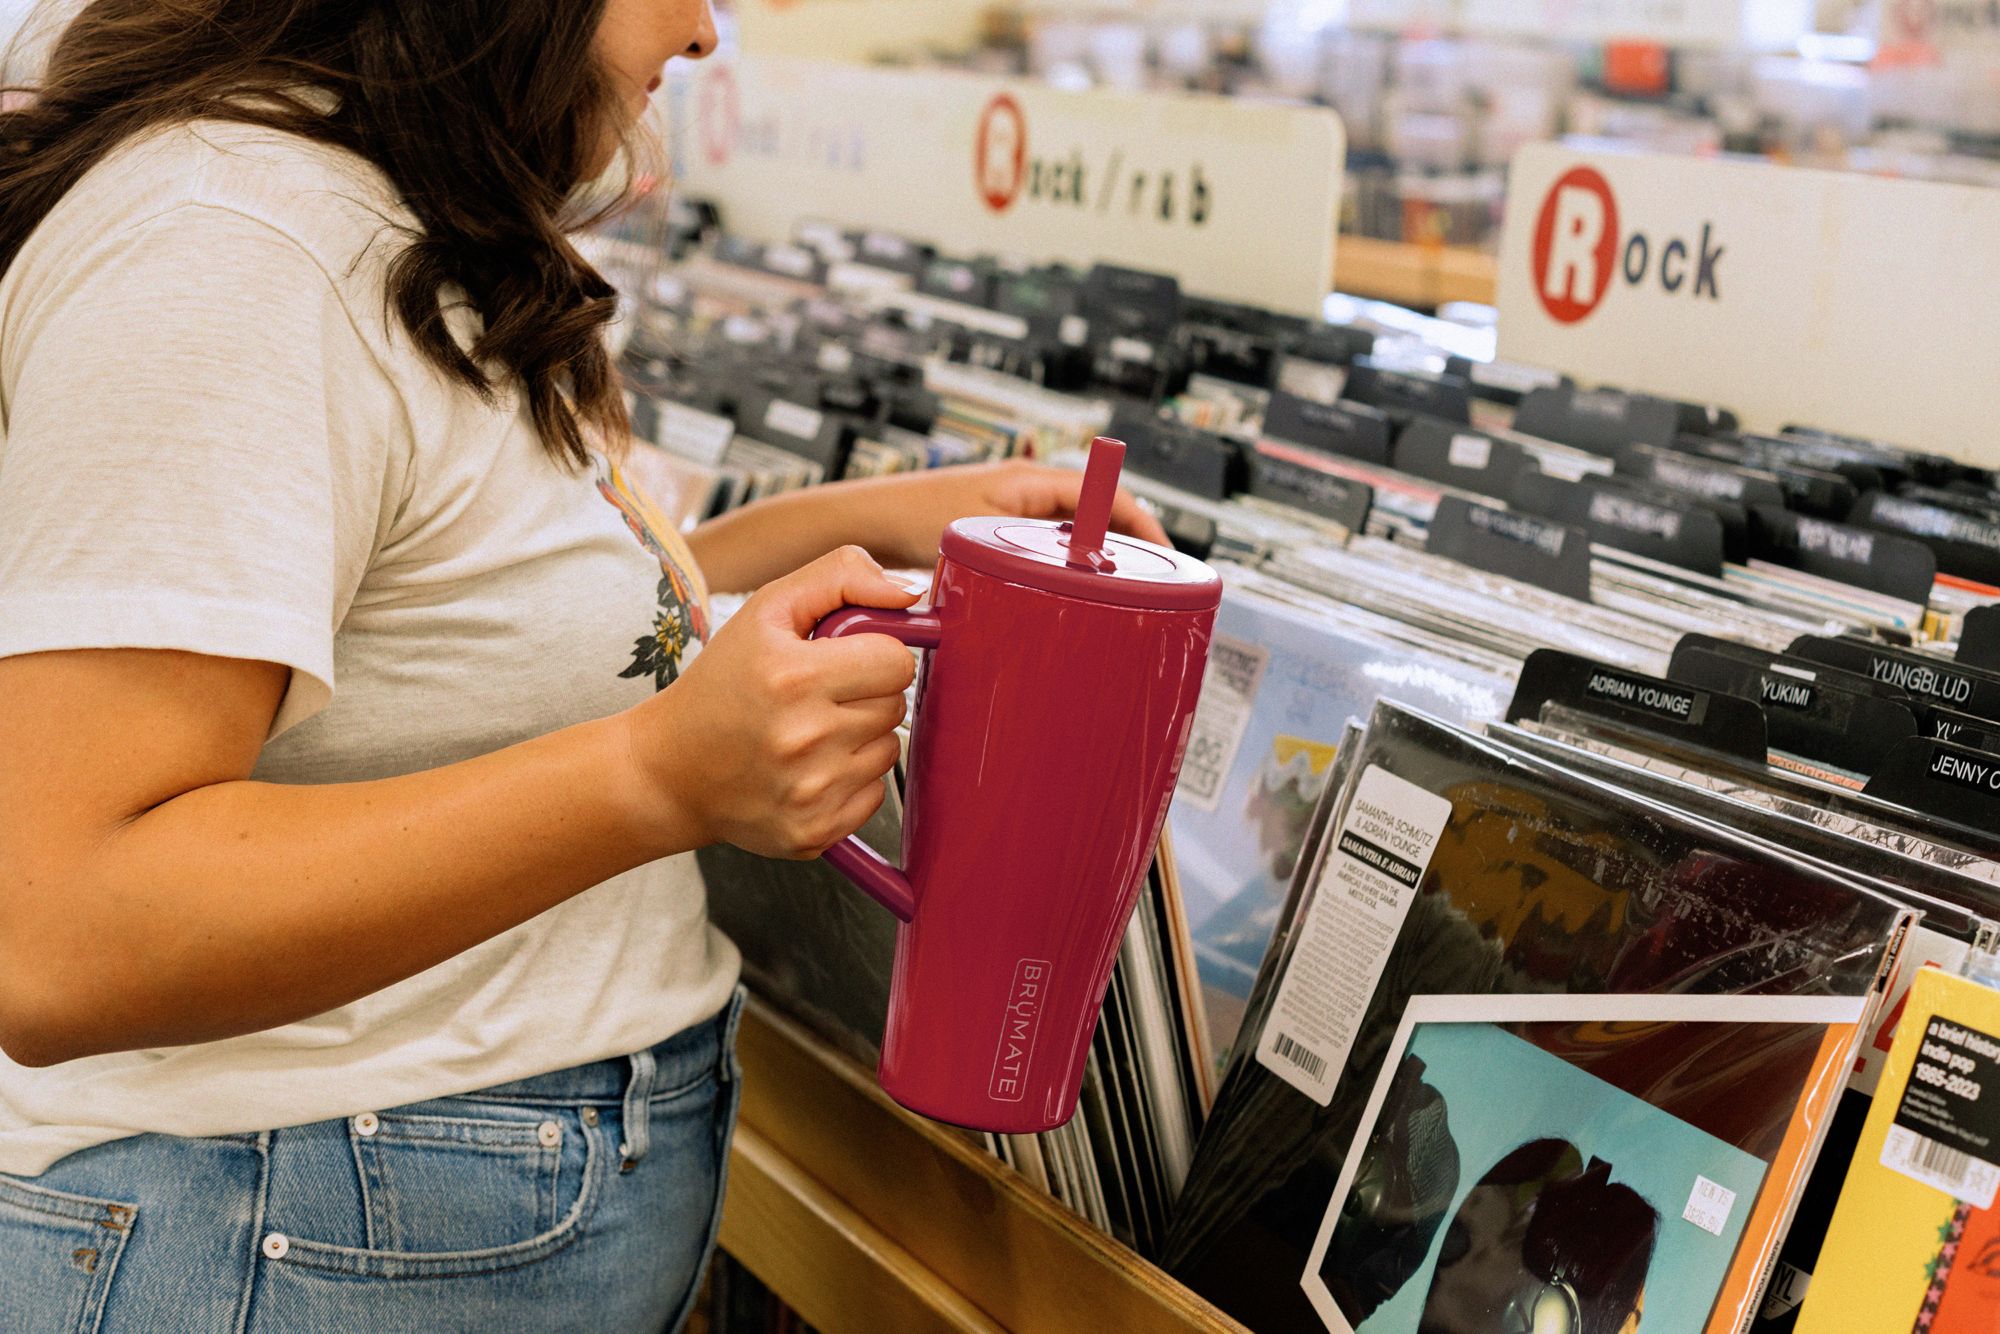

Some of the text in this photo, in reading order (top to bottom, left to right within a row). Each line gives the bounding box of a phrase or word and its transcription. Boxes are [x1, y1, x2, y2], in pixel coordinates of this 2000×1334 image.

[1540, 178, 1724, 316] Rock
[1588, 674, 1691, 715] ADRIAN YOUNGE
[1761, 677, 1810, 706] YUKIMI
[1872, 657, 1970, 702] YUNGBLUD
[1932, 755, 1989, 784] JENNY
[1355, 800, 1396, 827] SAMANTHA
[1362, 820, 1389, 841] ADRIAN
[1390, 832, 1421, 858] YOUNGE
[1341, 836, 1418, 883] SAMANTHA E ADRIAN
[1927, 1022, 1939, 1036] a
[1937, 1023, 1967, 1046] brief
[1920, 1040, 1976, 1075] indie pop
[1915, 1062, 1981, 1101] 1985-2023
